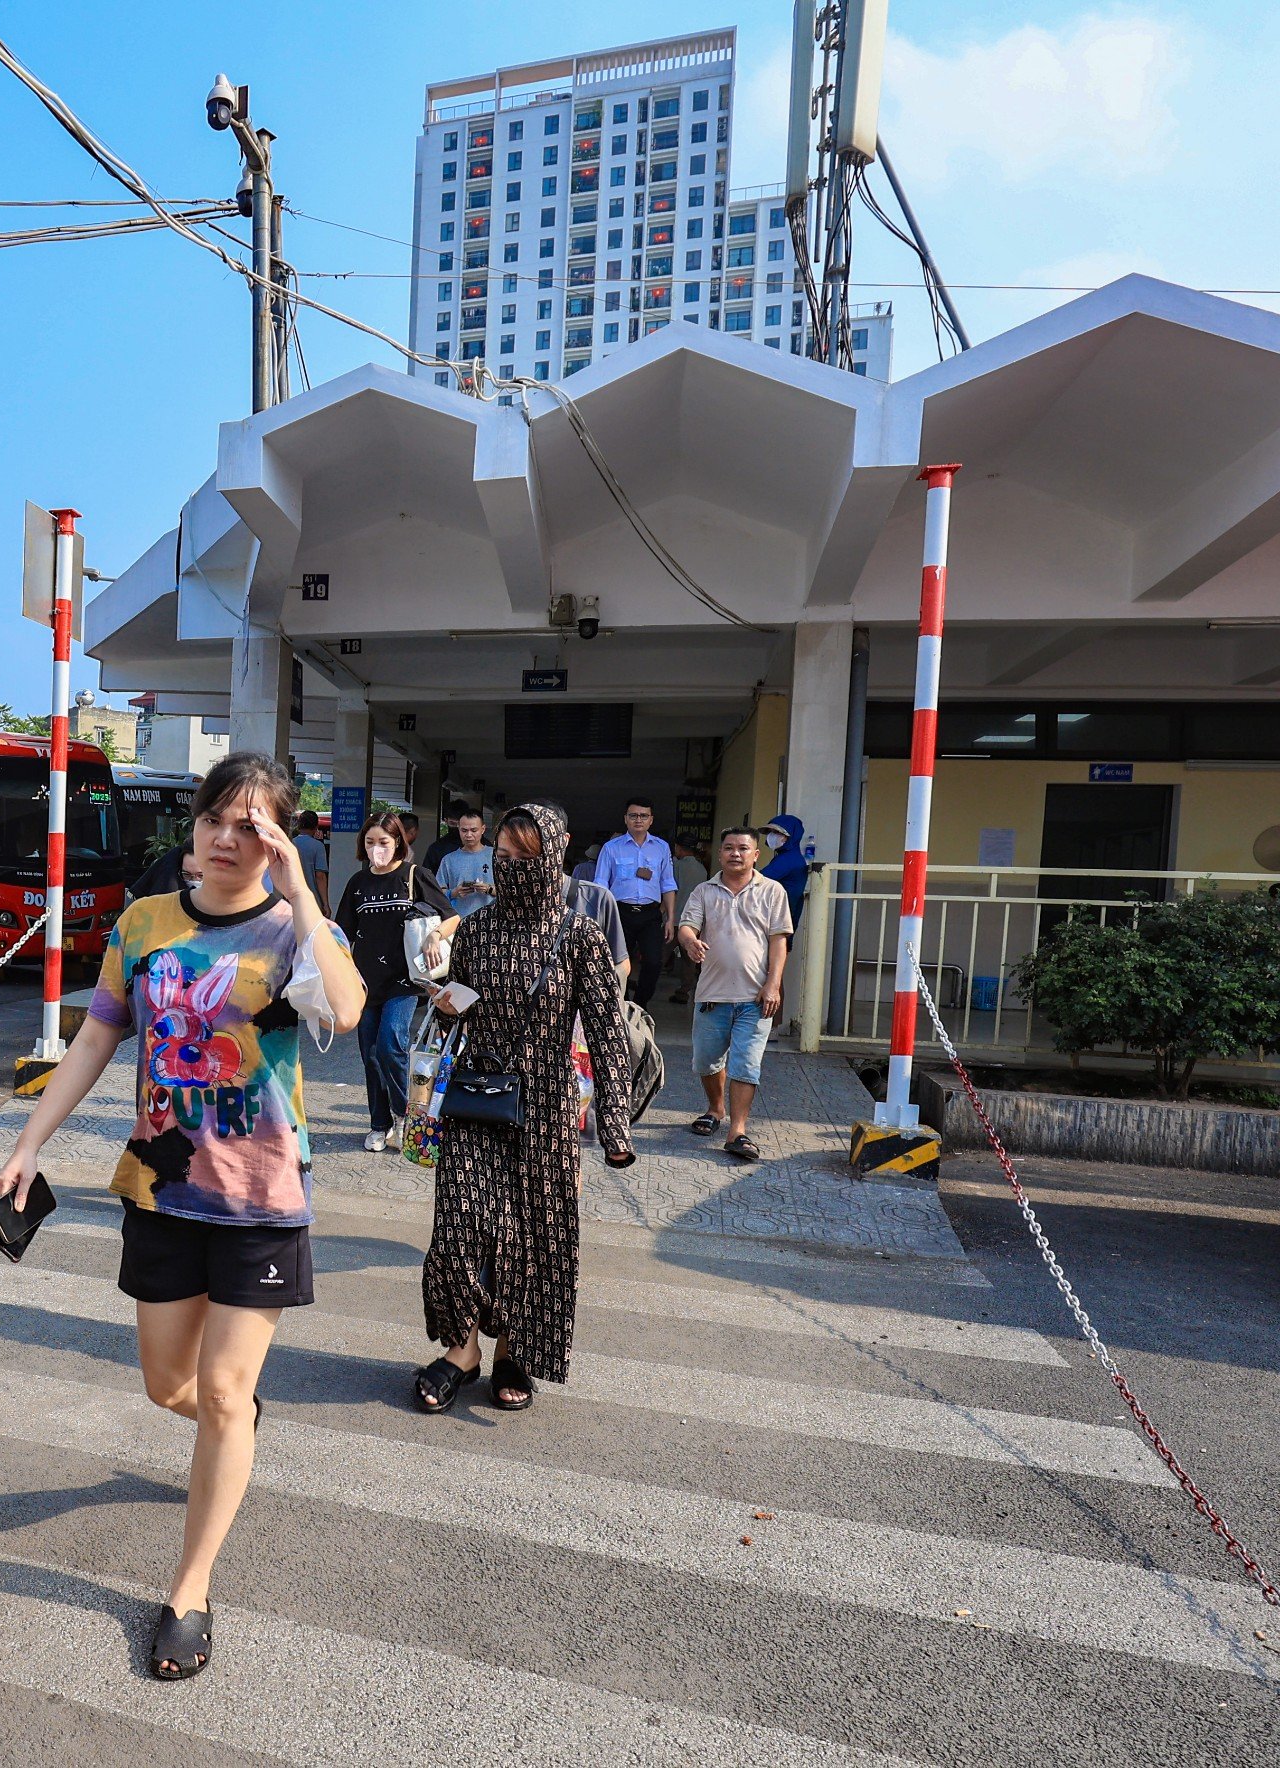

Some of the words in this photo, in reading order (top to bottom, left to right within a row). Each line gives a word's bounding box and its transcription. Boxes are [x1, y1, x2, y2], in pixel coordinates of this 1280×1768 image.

[308, 584, 326, 598] 19
[344, 640, 360, 652] 18
[529, 677, 543, 685] WC
[402, 720, 415, 729] 17
[123, 789, 141, 801] NAM
[142, 789, 161, 804] ĐỊNH
[70, 889, 96, 909] KẾT
[364, 893, 398, 901] LUCID
